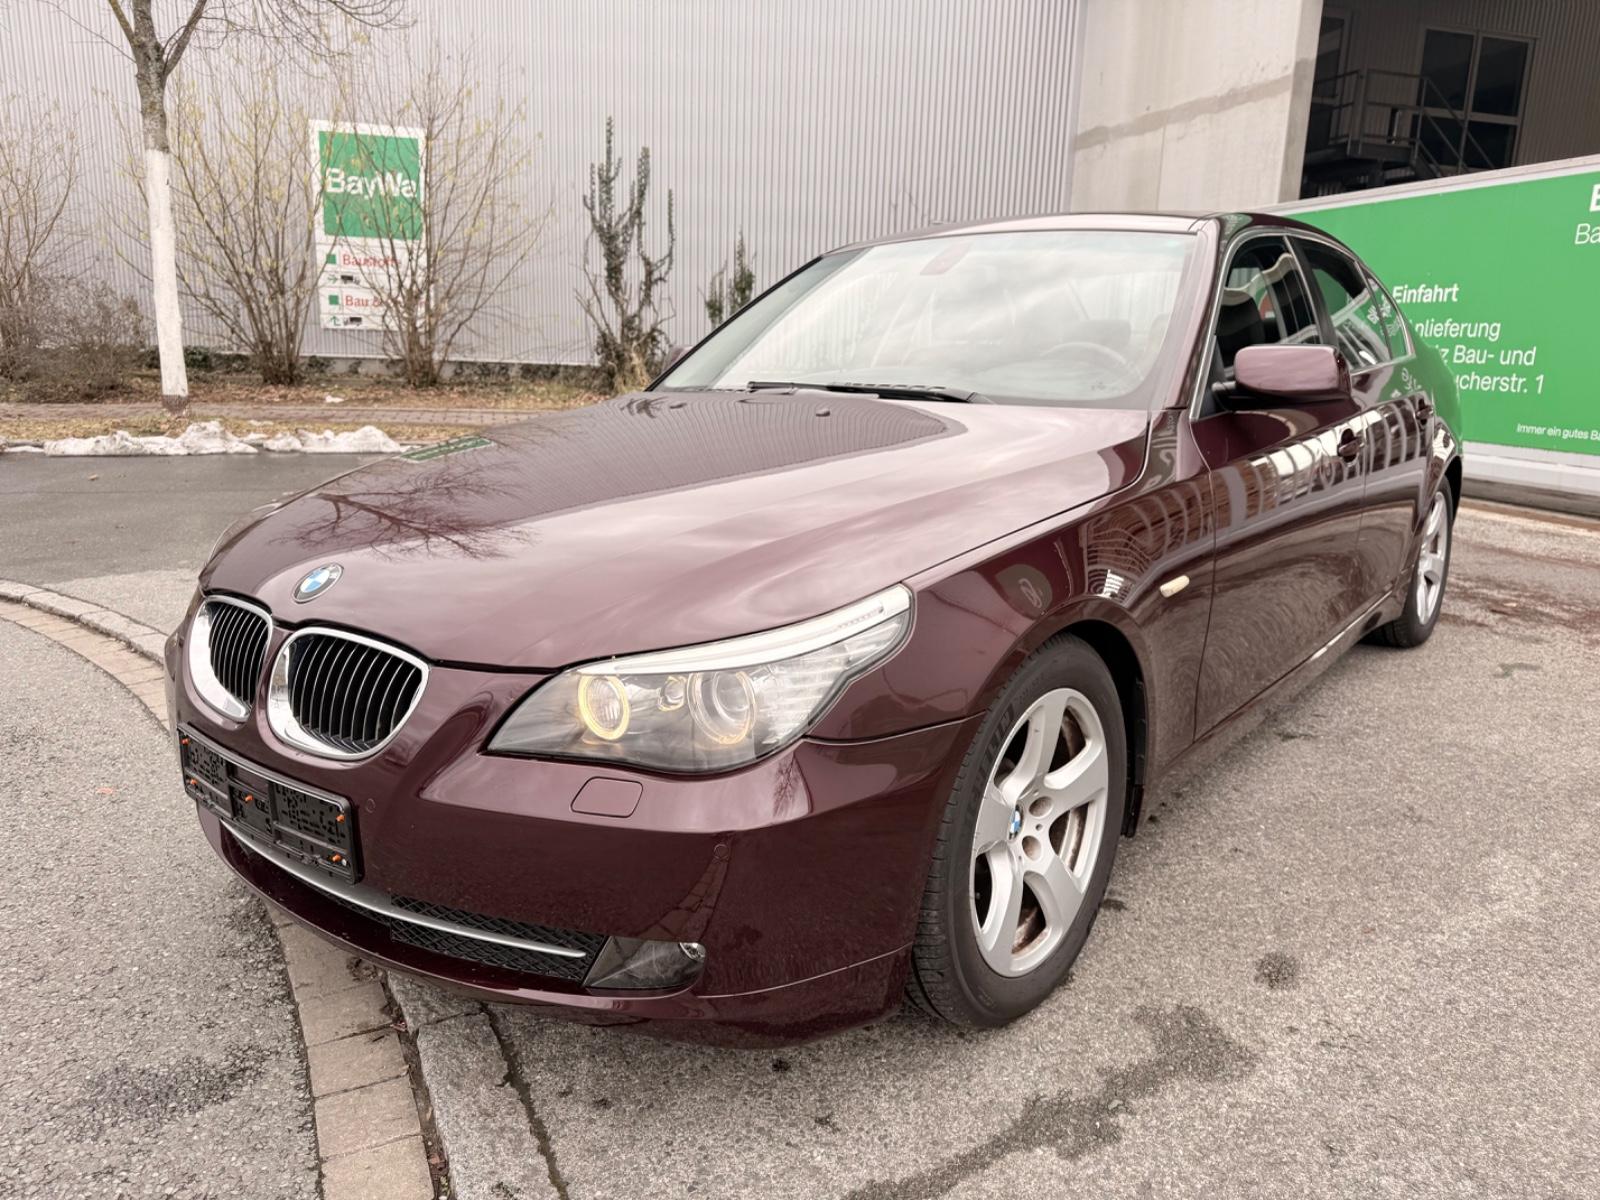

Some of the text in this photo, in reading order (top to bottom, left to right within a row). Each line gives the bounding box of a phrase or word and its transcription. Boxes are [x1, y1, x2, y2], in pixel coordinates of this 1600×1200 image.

[325, 167, 417, 200] BayWa
[345, 295, 369, 307] Bau
[1392, 283, 1459, 303] Einfahrt
[1409, 318, 1501, 342] nlieferung
[1452, 344, 1495, 365] Bau-
[1499, 346, 1537, 366] und
[1535, 373, 1545, 395] 1
[1516, 423, 1547, 436] Immer
[1546, 426, 1562, 437] ein
[1562, 428, 1590, 440] gutes
